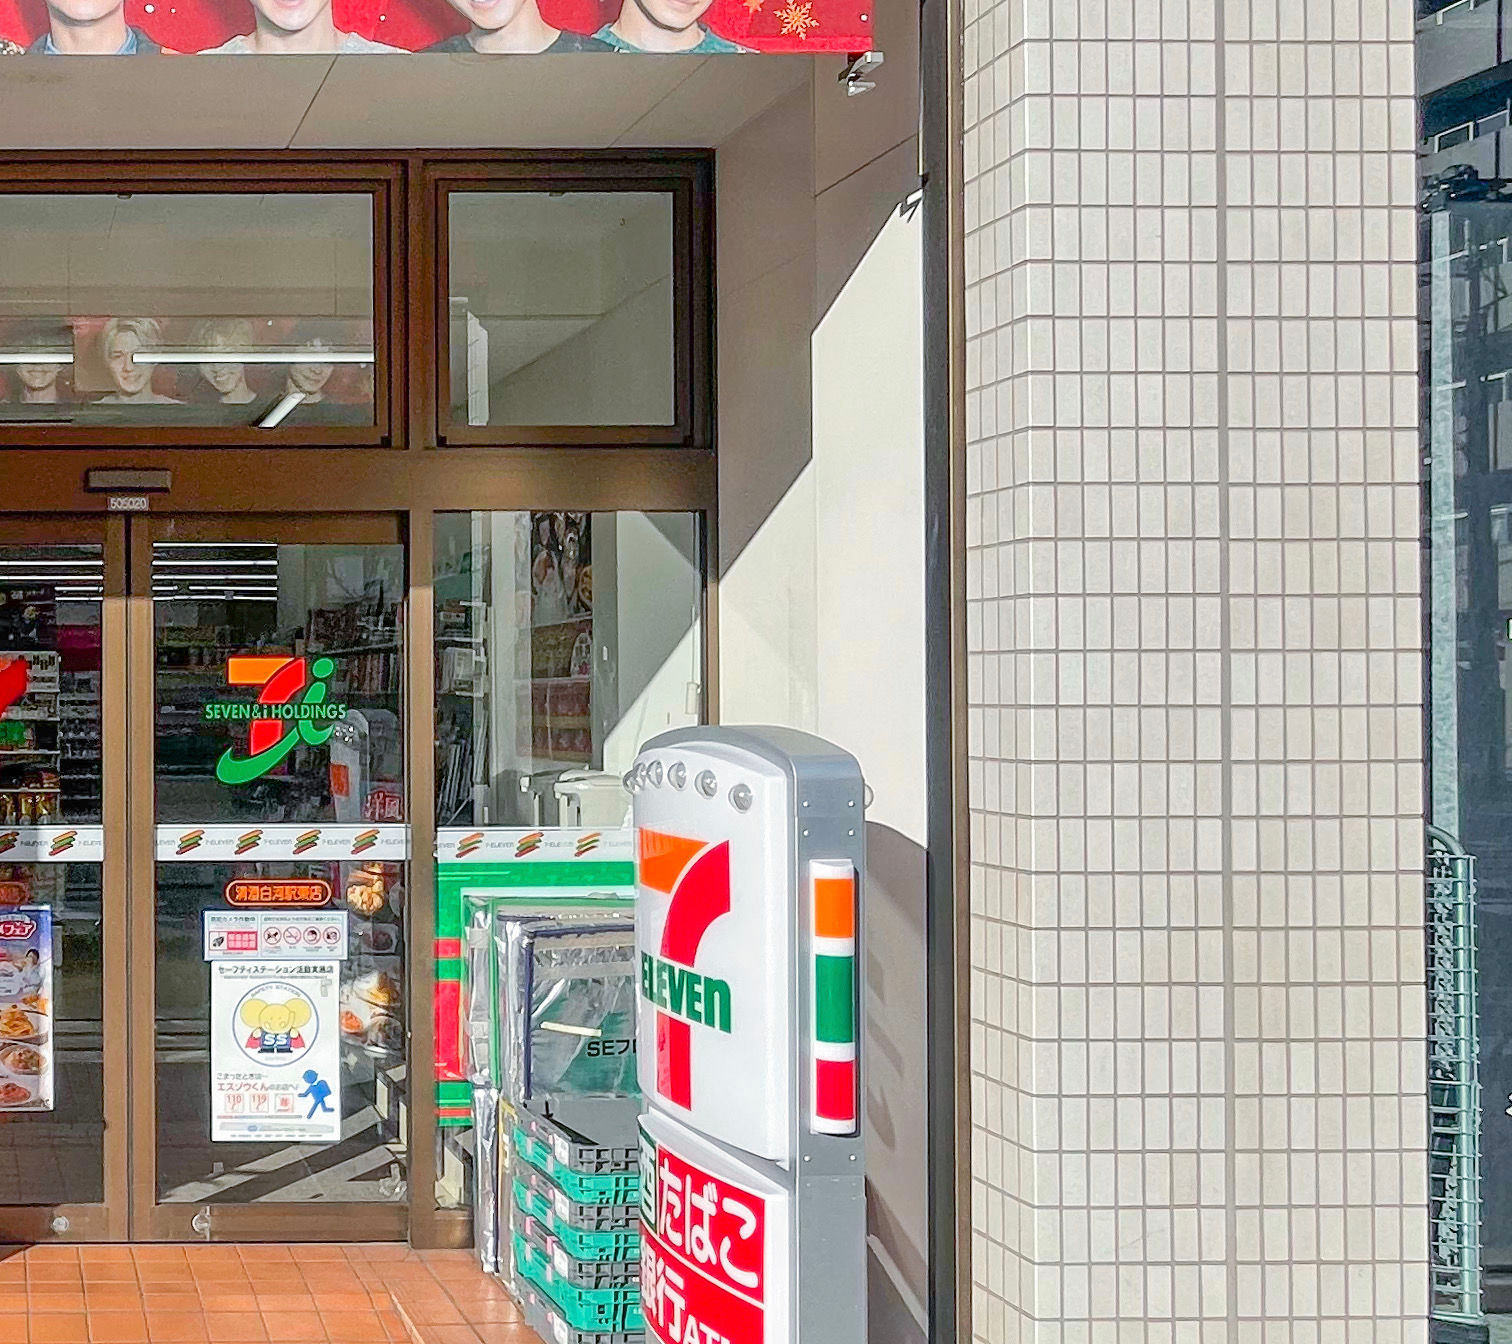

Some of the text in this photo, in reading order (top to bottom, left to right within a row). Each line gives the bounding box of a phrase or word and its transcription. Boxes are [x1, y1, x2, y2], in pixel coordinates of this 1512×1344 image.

[110, 497, 147, 509] 505020
[271, 703, 347, 719] HOLDINGS
[263, 1034, 288, 1046] SS
[659, 1156, 760, 1290] たばこ
